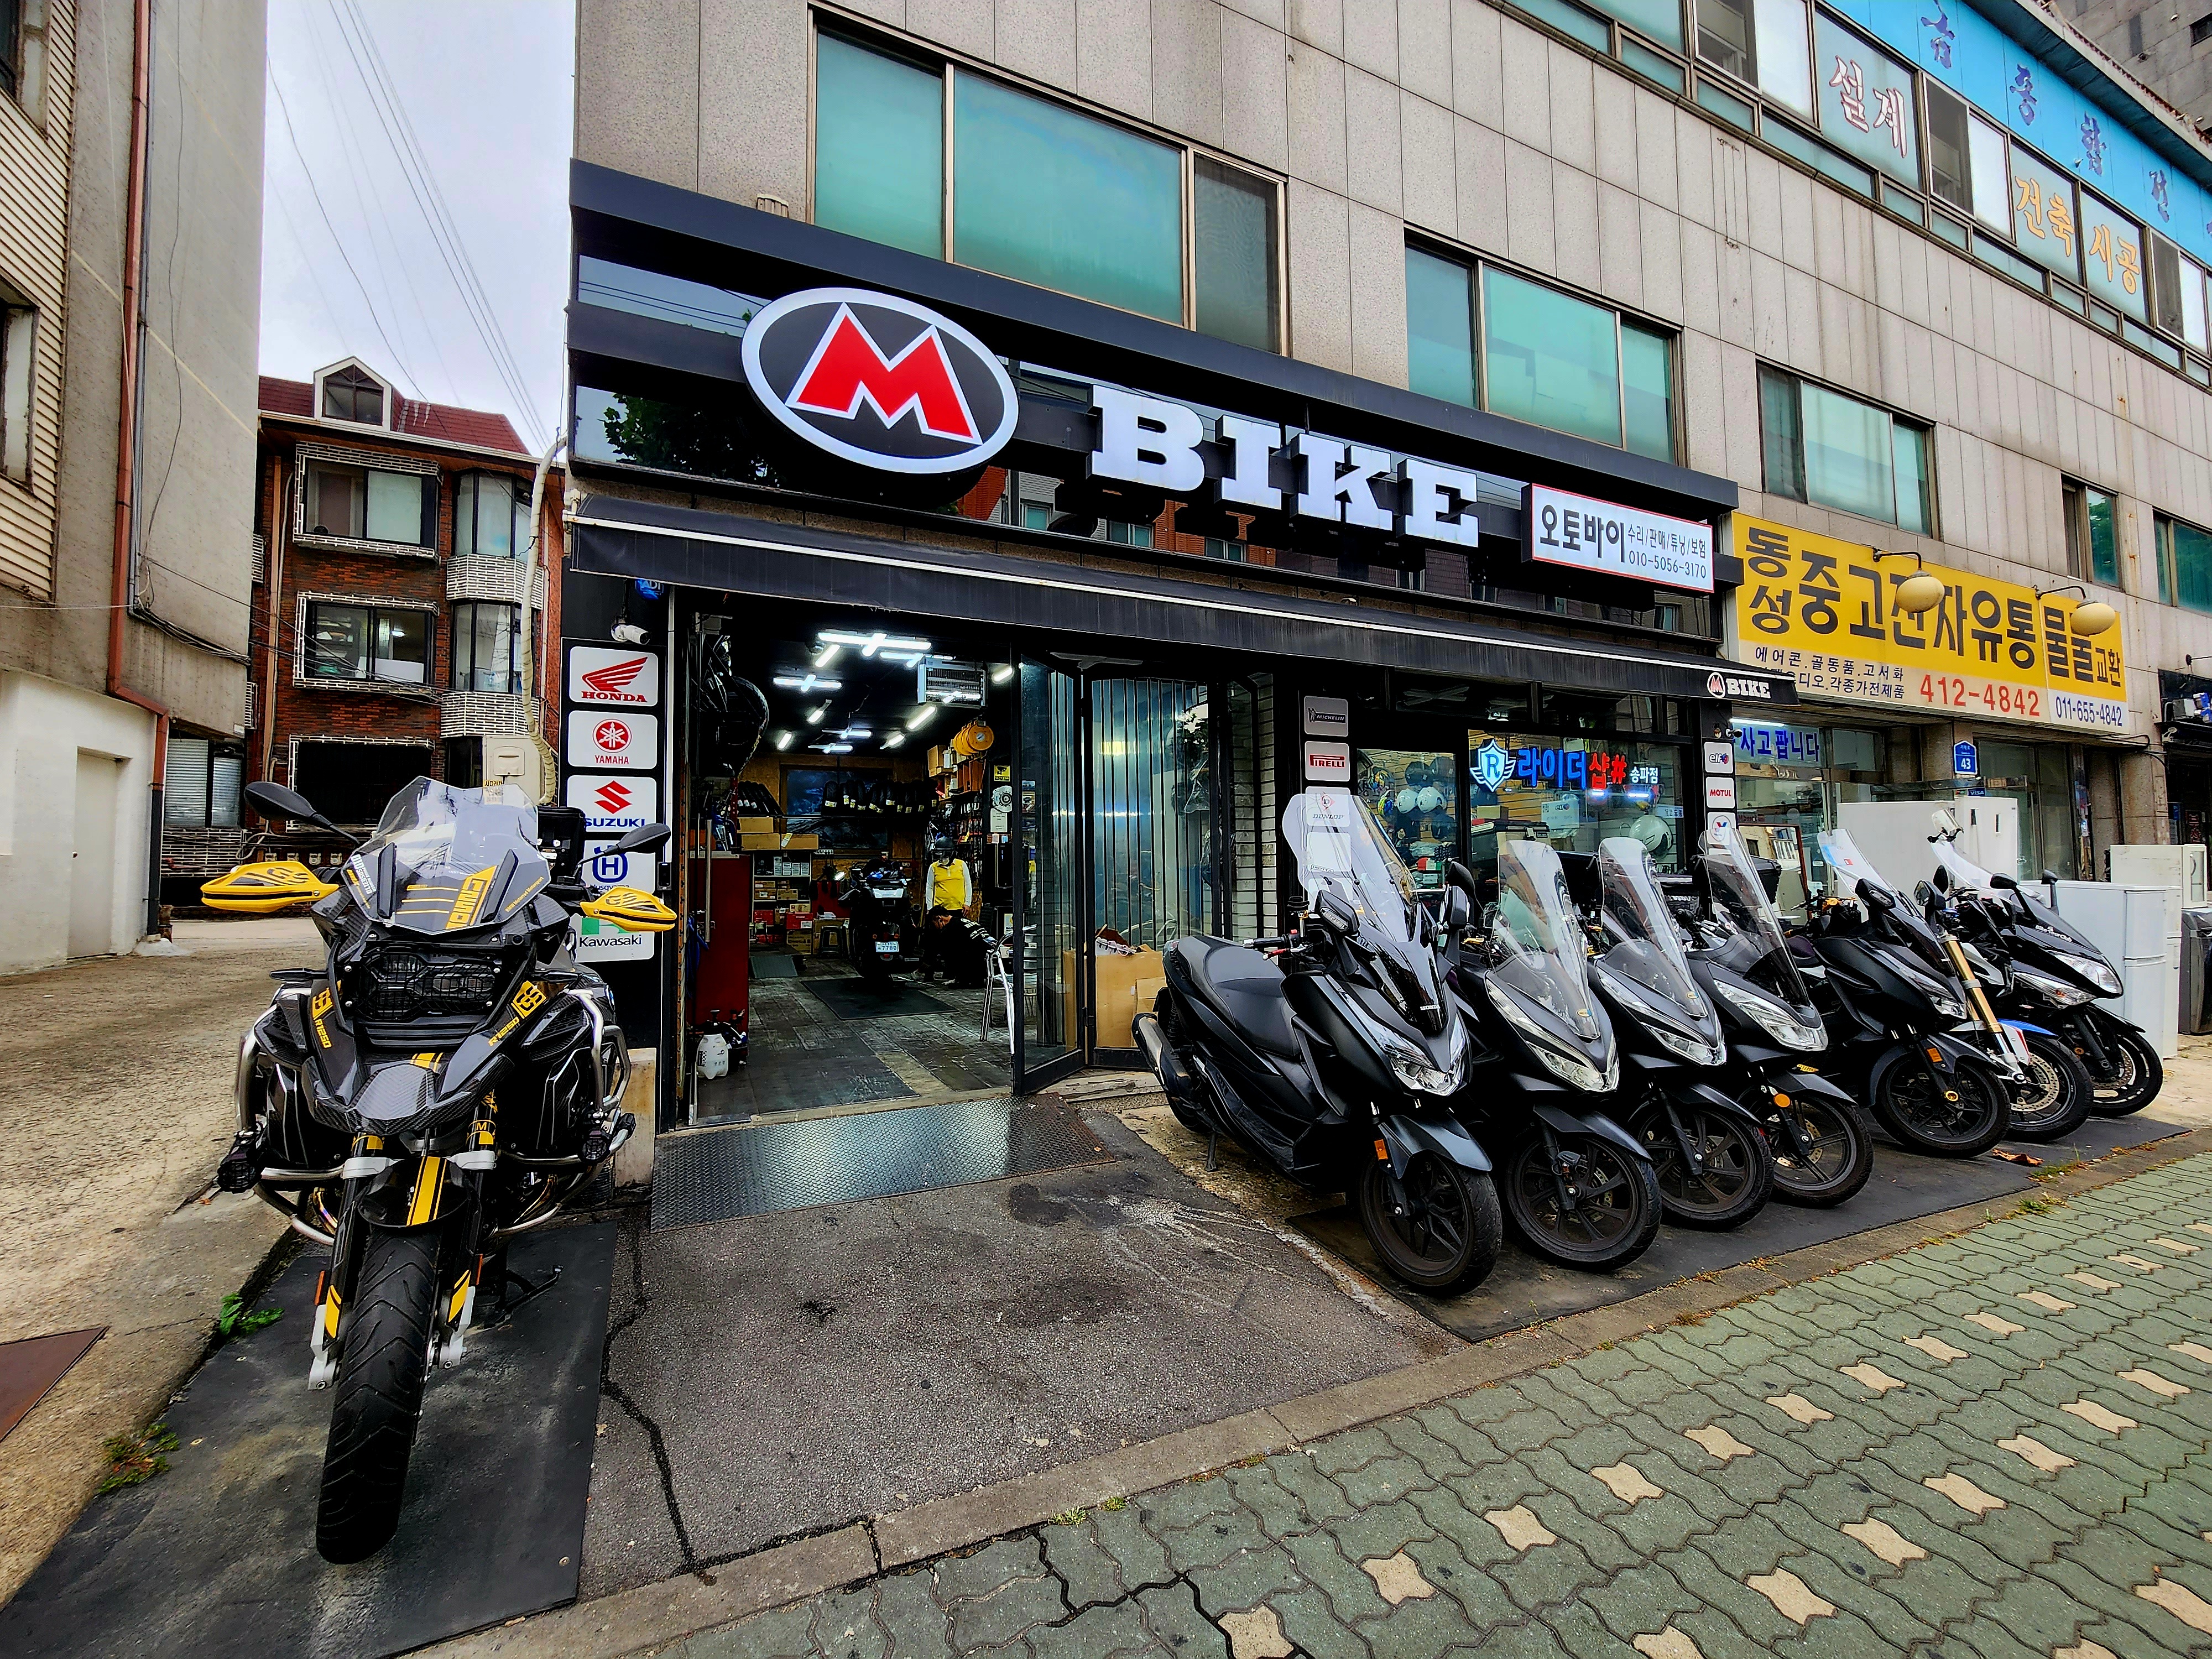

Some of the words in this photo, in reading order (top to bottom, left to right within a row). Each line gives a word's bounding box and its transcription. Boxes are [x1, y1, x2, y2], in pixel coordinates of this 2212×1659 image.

[1829, 55, 1907, 158] 설계
[2015, 175, 2075, 257] 건축
[2090, 224, 2141, 295] 시공
[785, 302, 983, 445] M
[1088, 384, 1479, 547] BIKE
[1540, 504, 1625, 563] 오토바이
[1629, 551, 1707, 578] 010-5056-3170
[581, 691, 648, 702] HONDA
[1726, 678, 1771, 698] BIKE
[1920, 674, 2041, 717] 412-4842
[2056, 696, 2123, 727] 011-655-4842
[594, 755, 629, 764] YAMAHA
[1310, 754, 1345, 768] PIRELLI
[1486, 753, 1500, 778] R
[1709, 753, 1723, 763] elf
[1961, 758, 1971, 769] 43
[1630, 766, 1658, 784] 송파점
[585, 818, 645, 827] SUZUKI
[579, 935, 641, 947] Kawasaki
[315, 1019, 332, 1048] R1250
[488, 1016, 520, 1046] R1250
